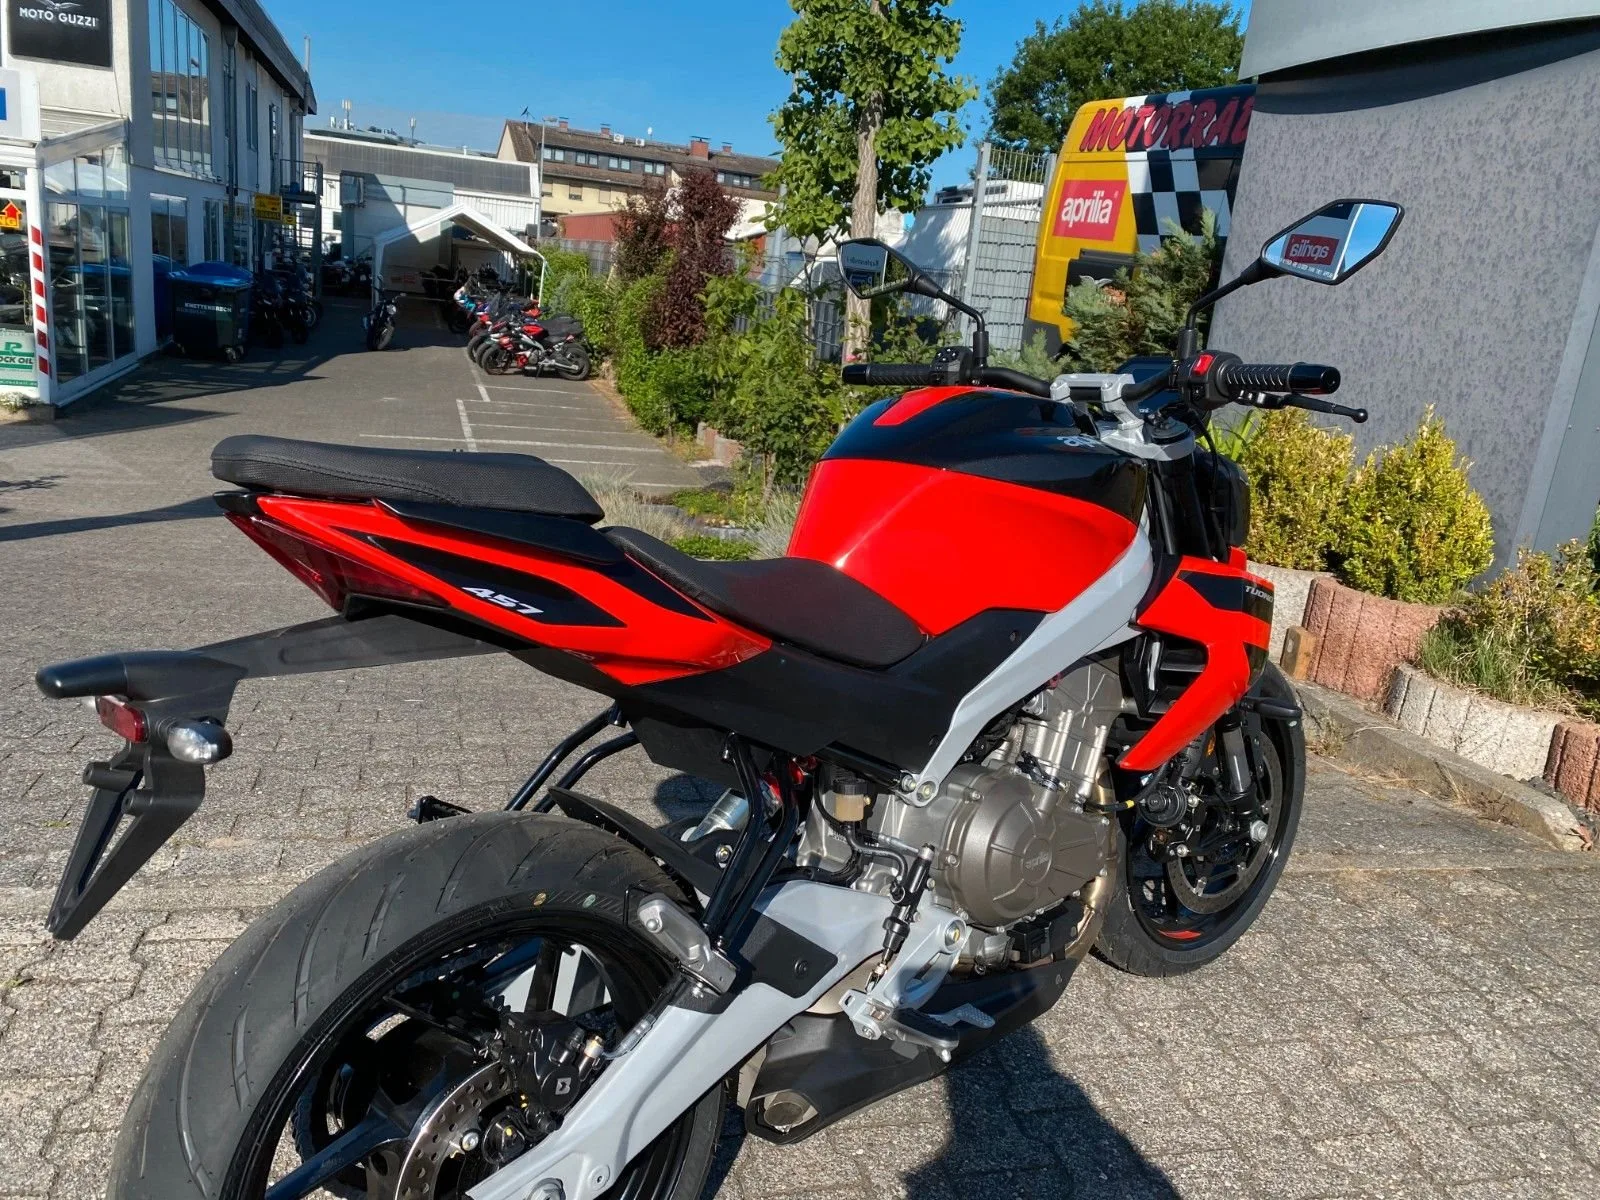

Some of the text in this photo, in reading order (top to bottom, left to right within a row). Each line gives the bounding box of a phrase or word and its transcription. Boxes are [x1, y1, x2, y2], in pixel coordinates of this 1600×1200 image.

[19, 7, 97, 27] MOTO GUZZI
[1061, 190, 1113, 228] aprilia
[461, 586, 544, 614] 457
[1245, 585, 1274, 603] TUONO
